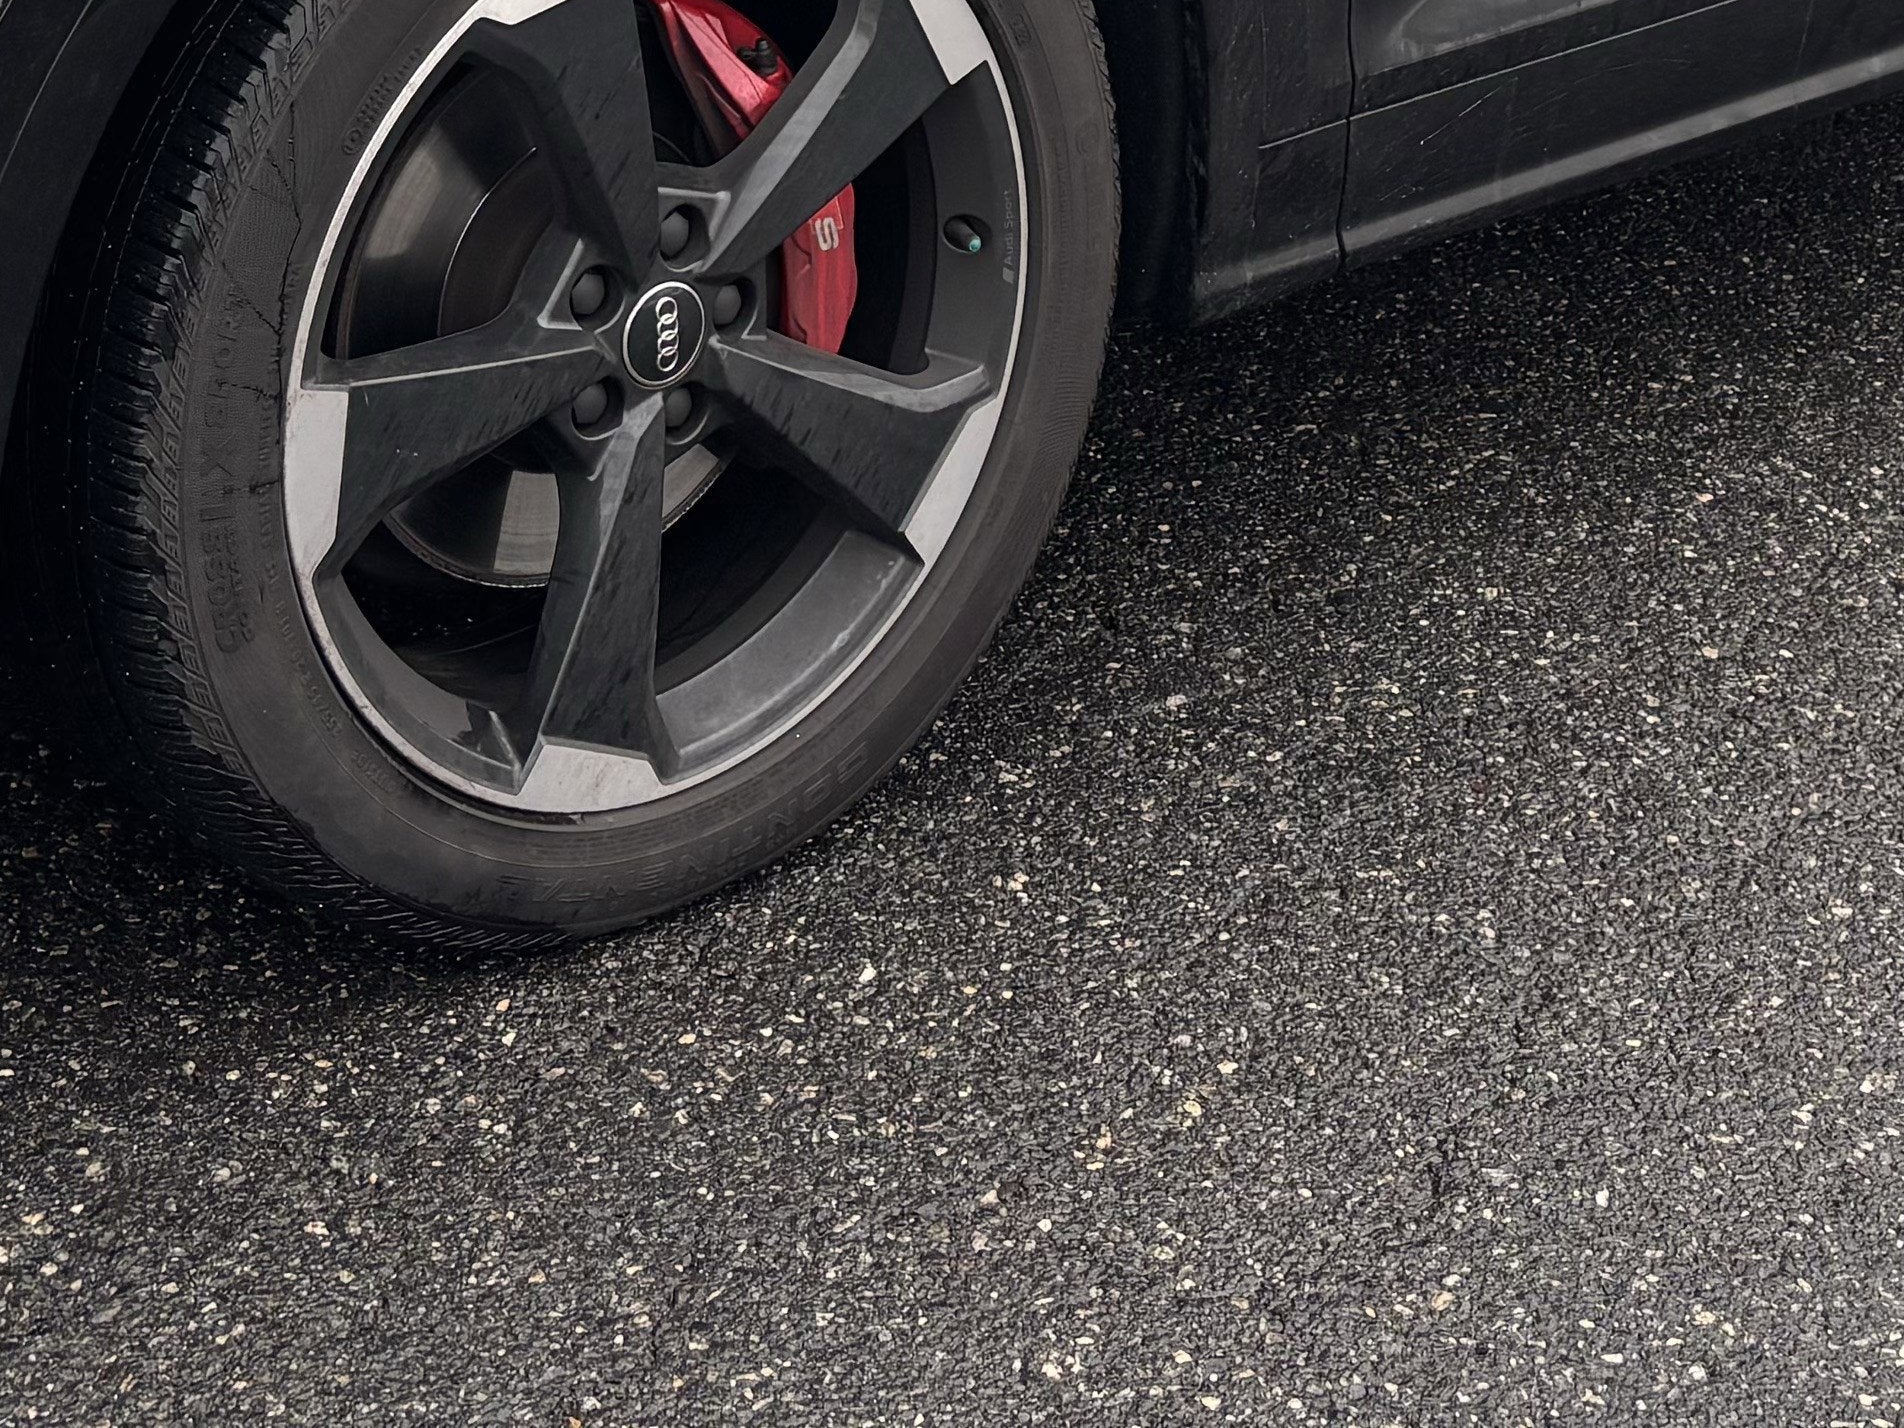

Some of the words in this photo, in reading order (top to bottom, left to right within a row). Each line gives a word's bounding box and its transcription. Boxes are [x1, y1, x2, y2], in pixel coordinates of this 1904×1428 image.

[1003, 190, 1018, 233] Sport
[815, 217, 839, 252] S
[1003, 235, 1013, 266] Audi
